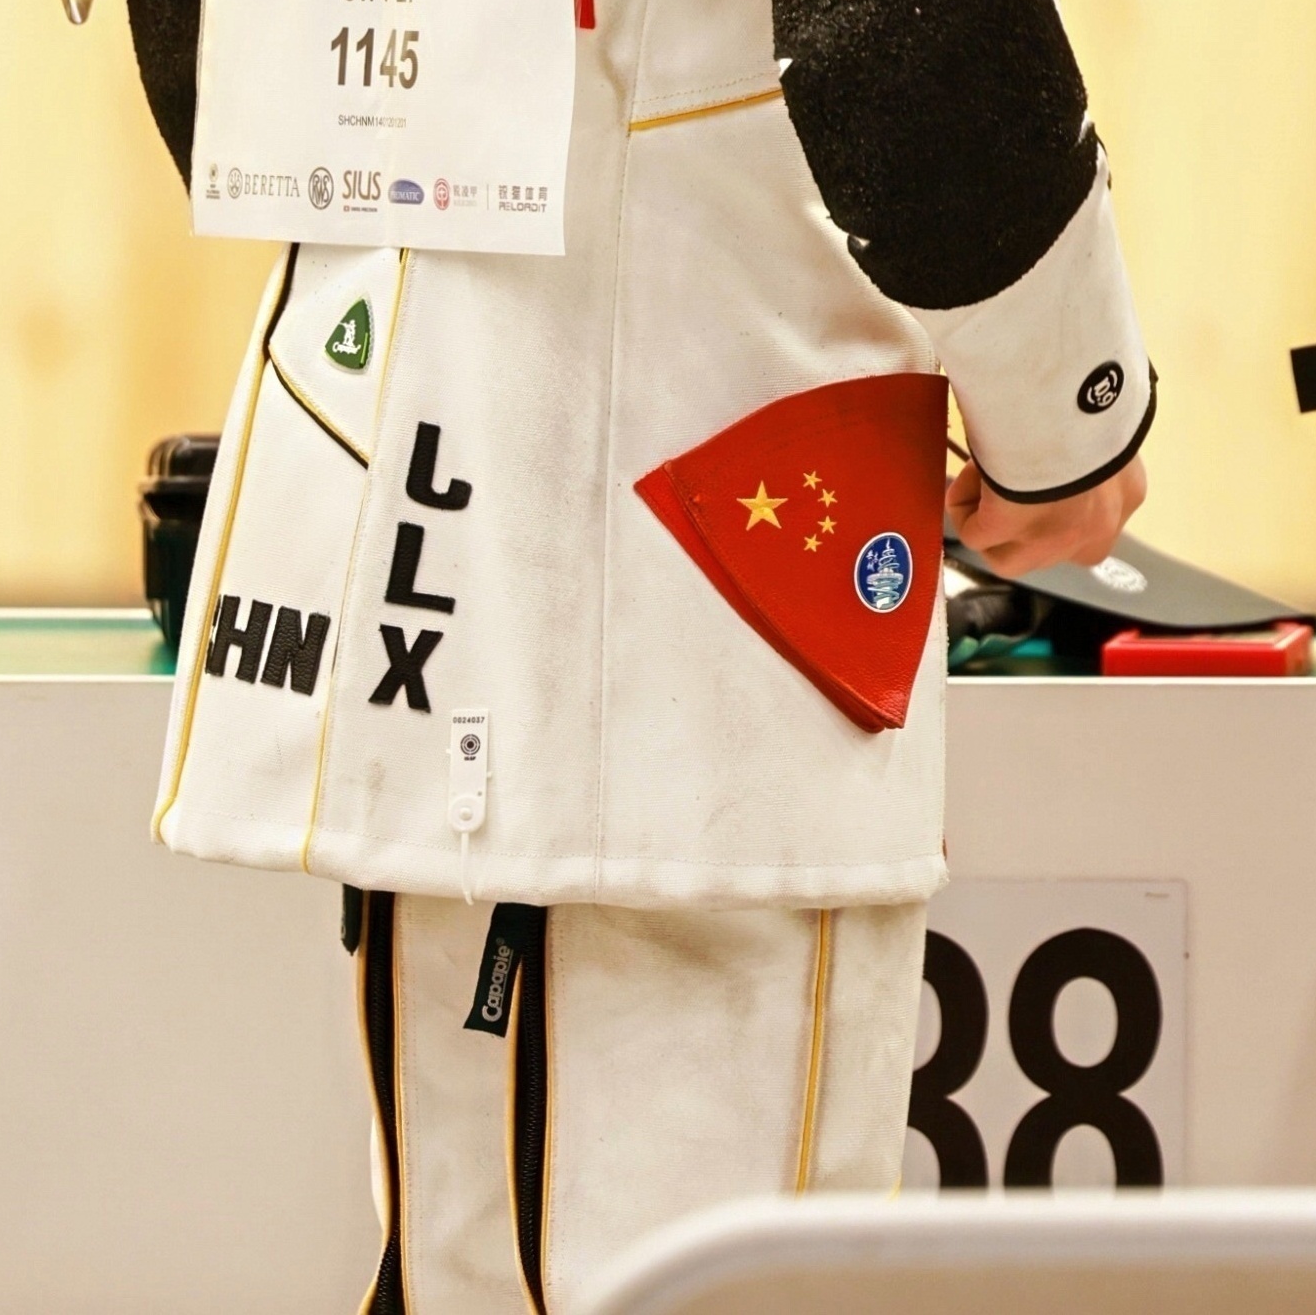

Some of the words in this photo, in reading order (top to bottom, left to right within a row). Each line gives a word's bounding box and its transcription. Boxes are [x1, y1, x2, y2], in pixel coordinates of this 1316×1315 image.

[331, 27, 419, 89] 1145
[244, 174, 300, 197] BERETTA
[342, 170, 381, 201] SIUS
[204, 594, 332, 697] HN
[482, 944, 514, 1023] Capapie
